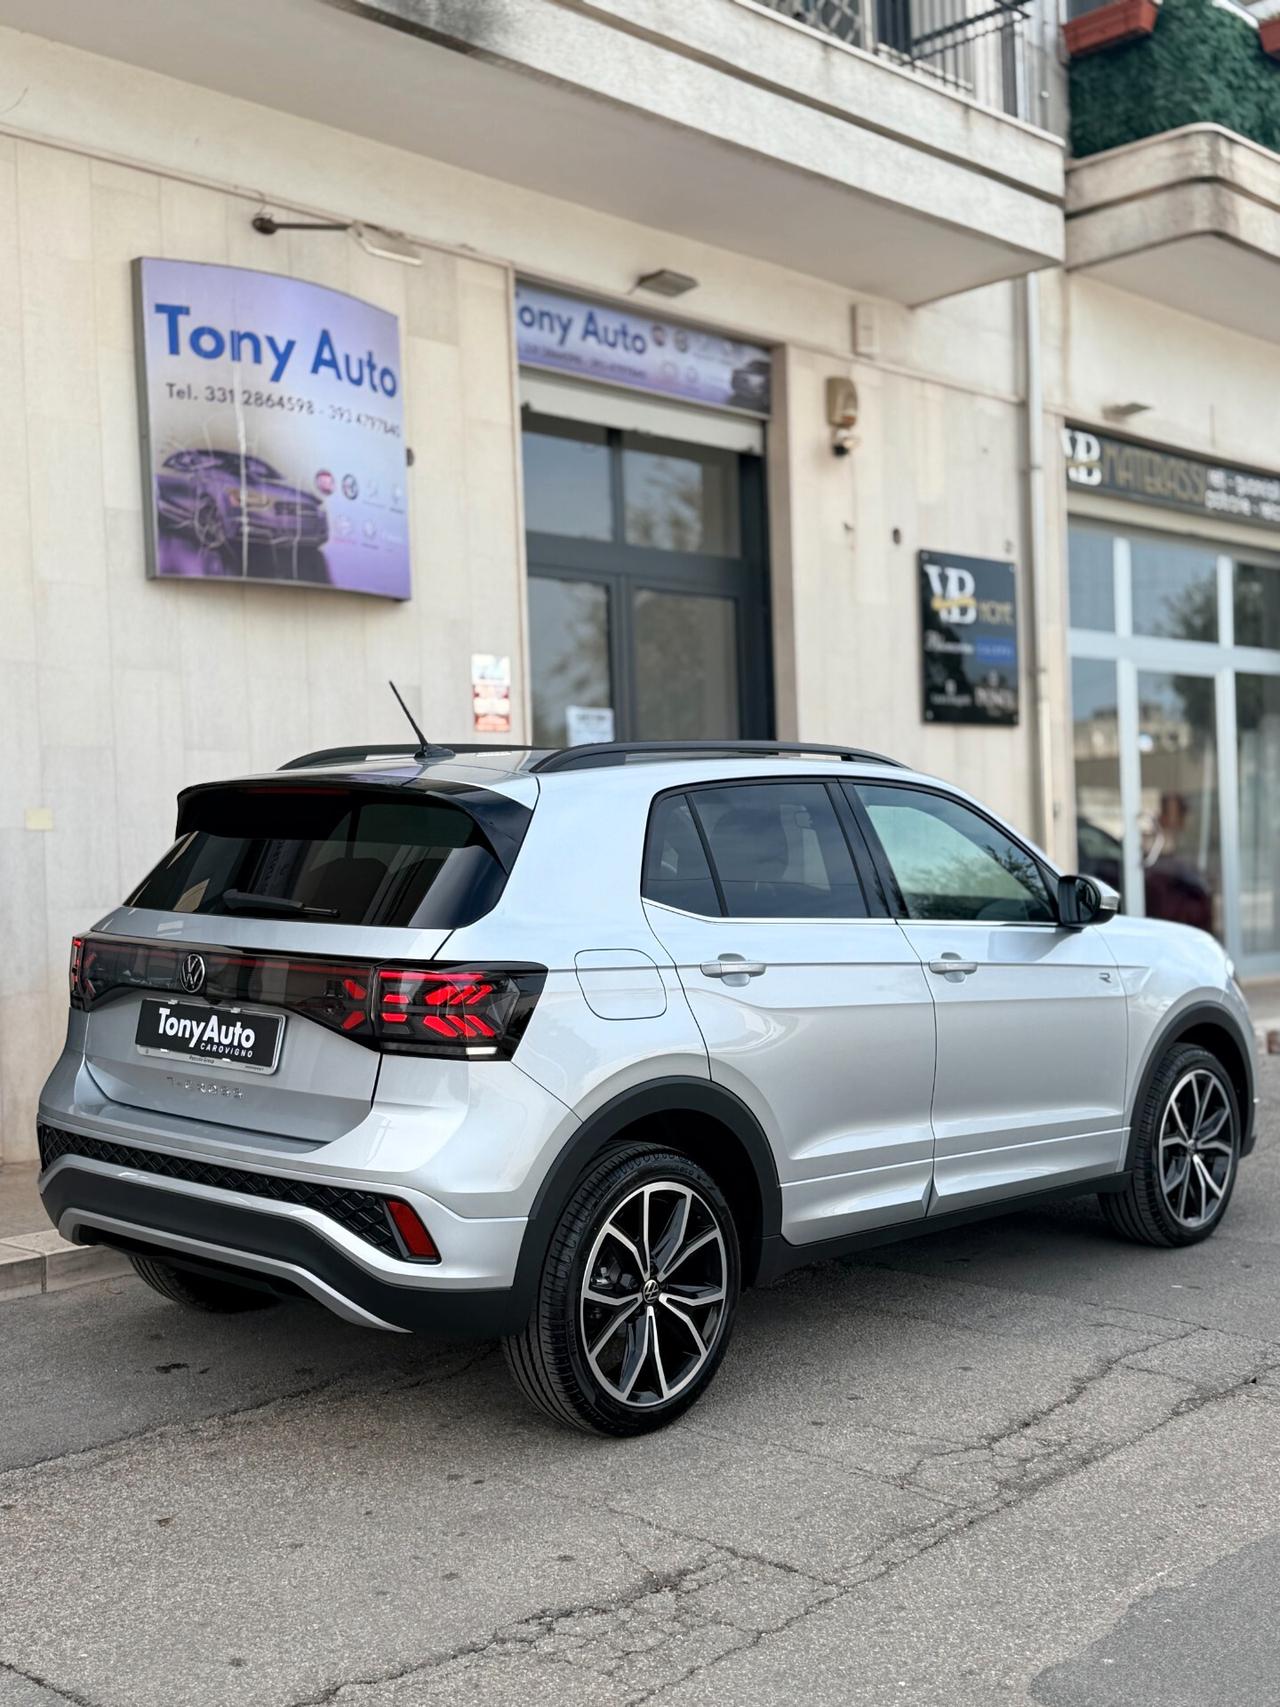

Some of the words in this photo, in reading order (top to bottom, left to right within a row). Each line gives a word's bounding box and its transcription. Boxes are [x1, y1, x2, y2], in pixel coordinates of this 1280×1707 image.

[518, 302, 572, 345] ony
[581, 311, 647, 354] Auto
[154, 303, 296, 382] Tony
[311, 328, 397, 397] Auto
[165, 382, 198, 400] Tel.
[205, 385, 235, 404] 331
[158, 1007, 256, 1049] TonyAuto
[200, 1042, 254, 1059] CAROVIGNO
